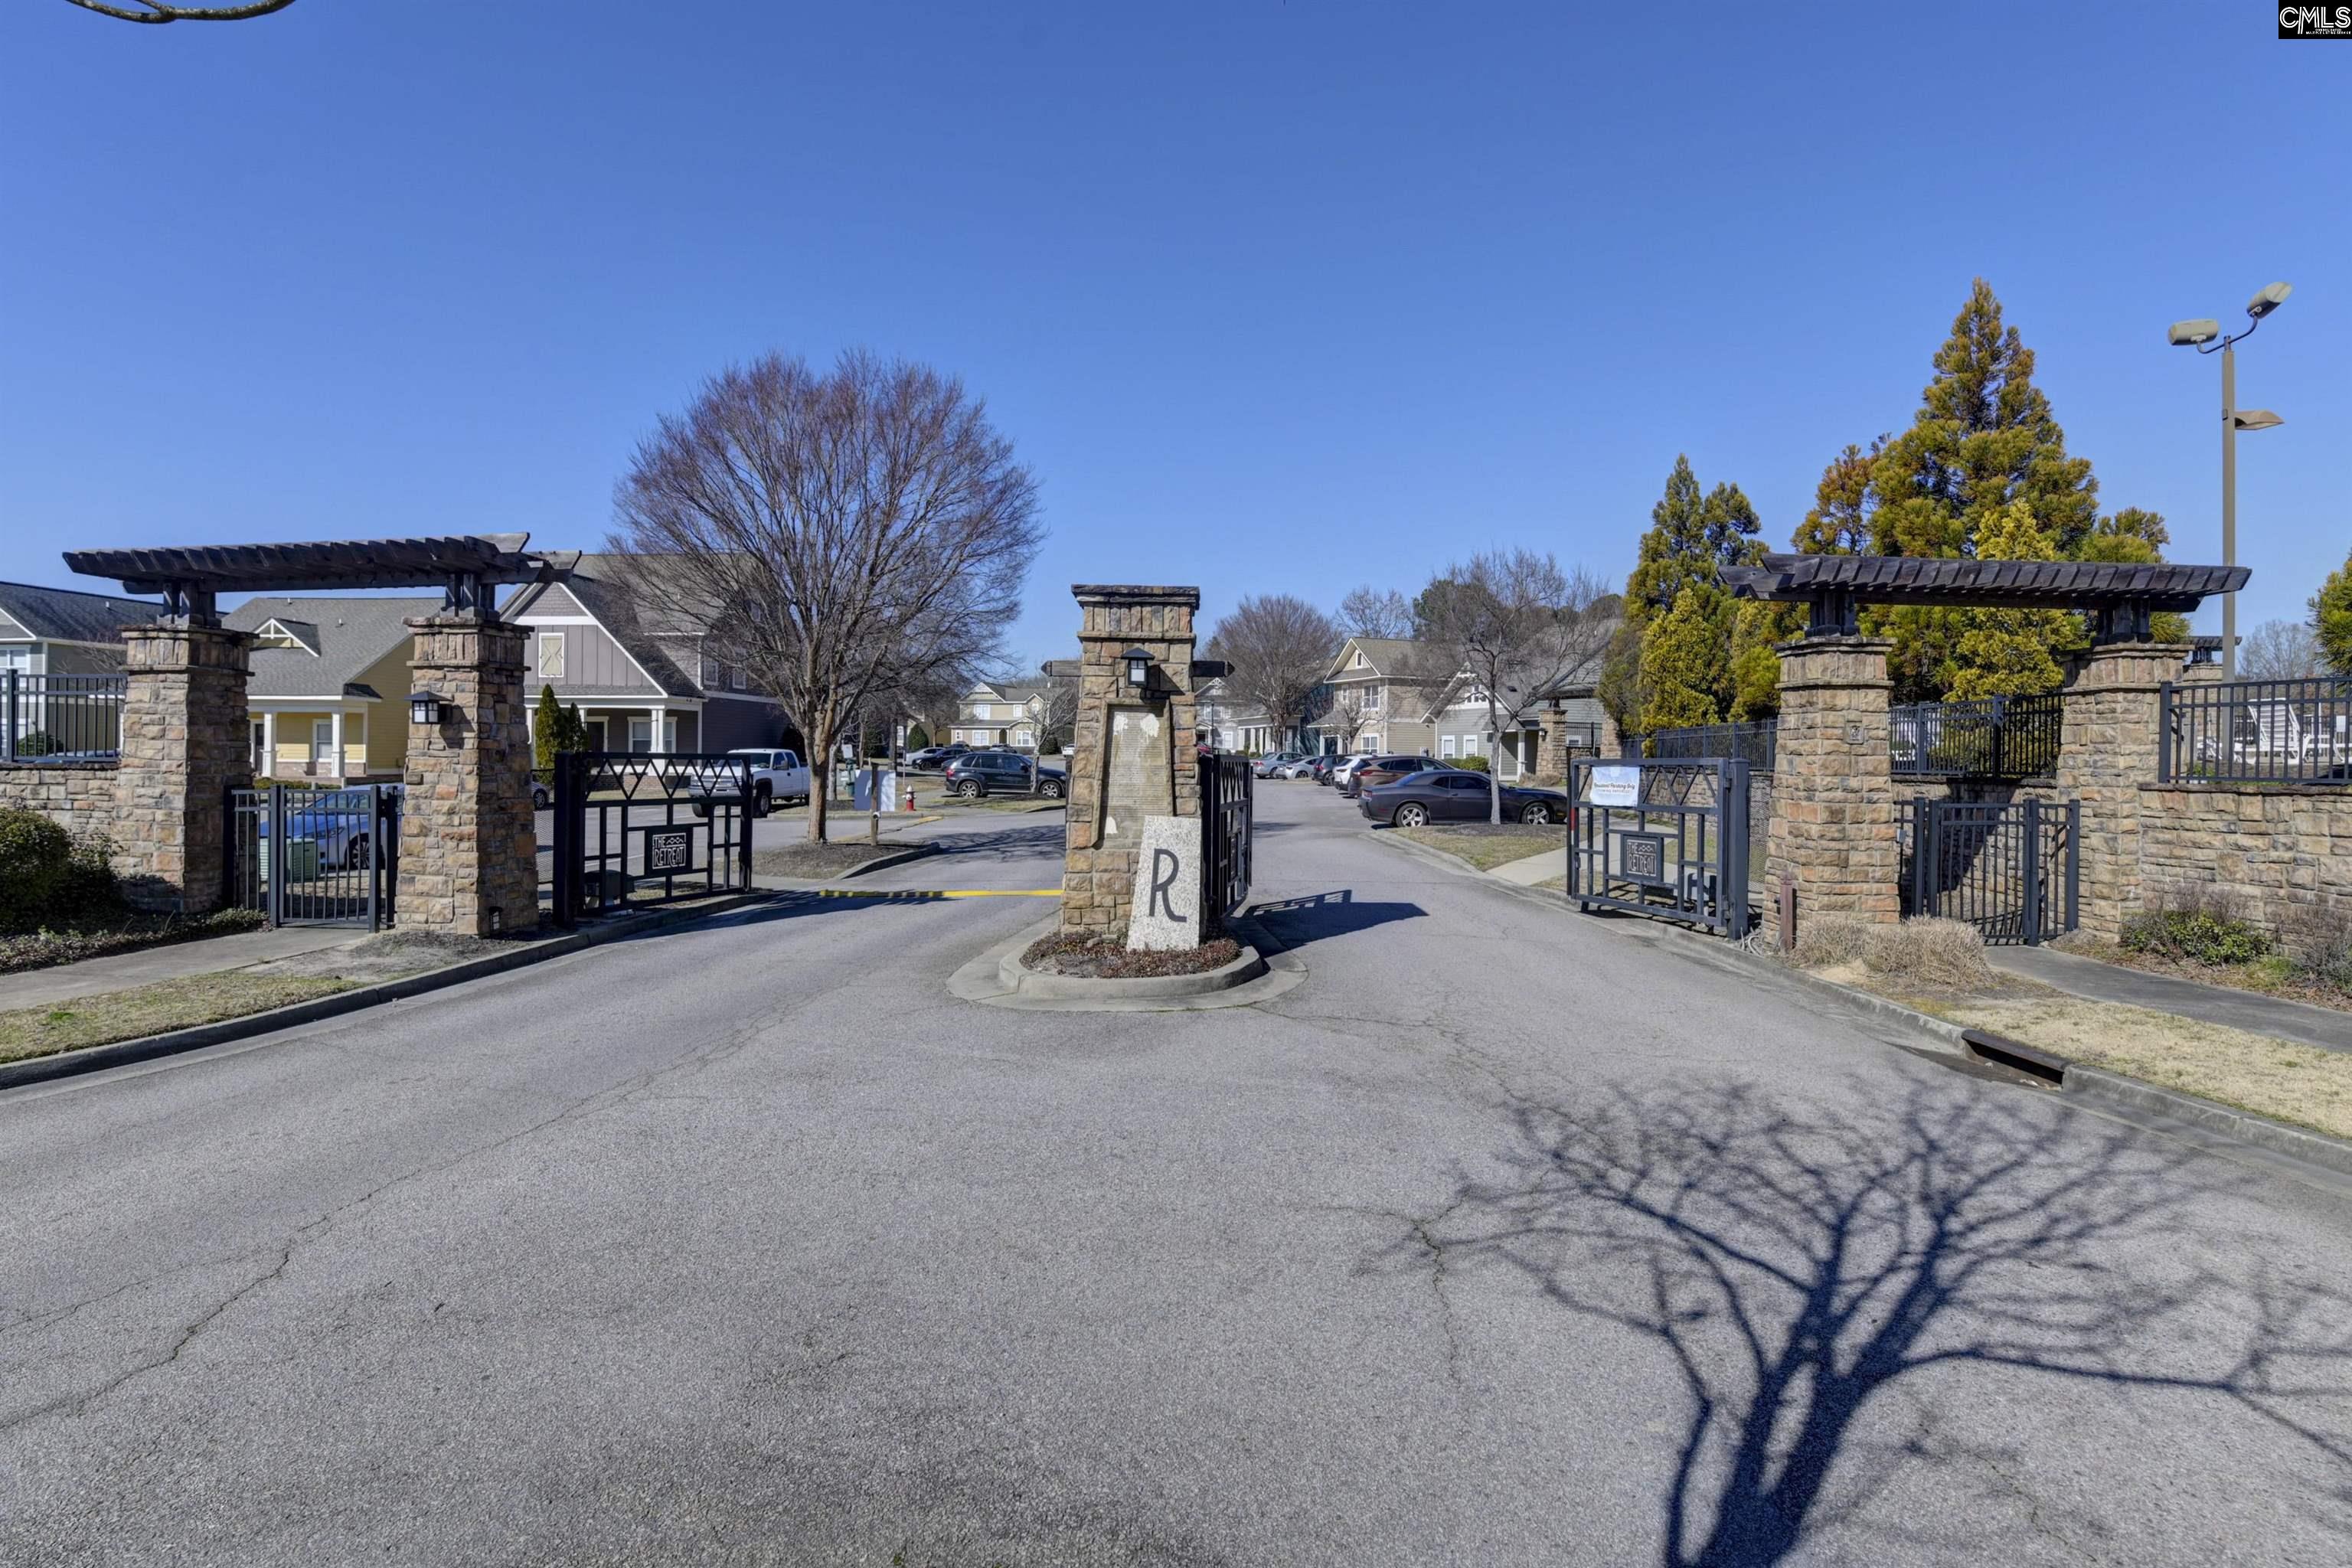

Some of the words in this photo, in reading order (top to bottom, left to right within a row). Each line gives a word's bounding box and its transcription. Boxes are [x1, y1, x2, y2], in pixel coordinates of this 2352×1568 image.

[654, 837, 666, 848] THE
[1628, 842, 1638, 854] THE
[655, 847, 684, 867] RETREAT
[1628, 854, 1654, 874] RETREAT
[1149, 848, 1187, 923] R
